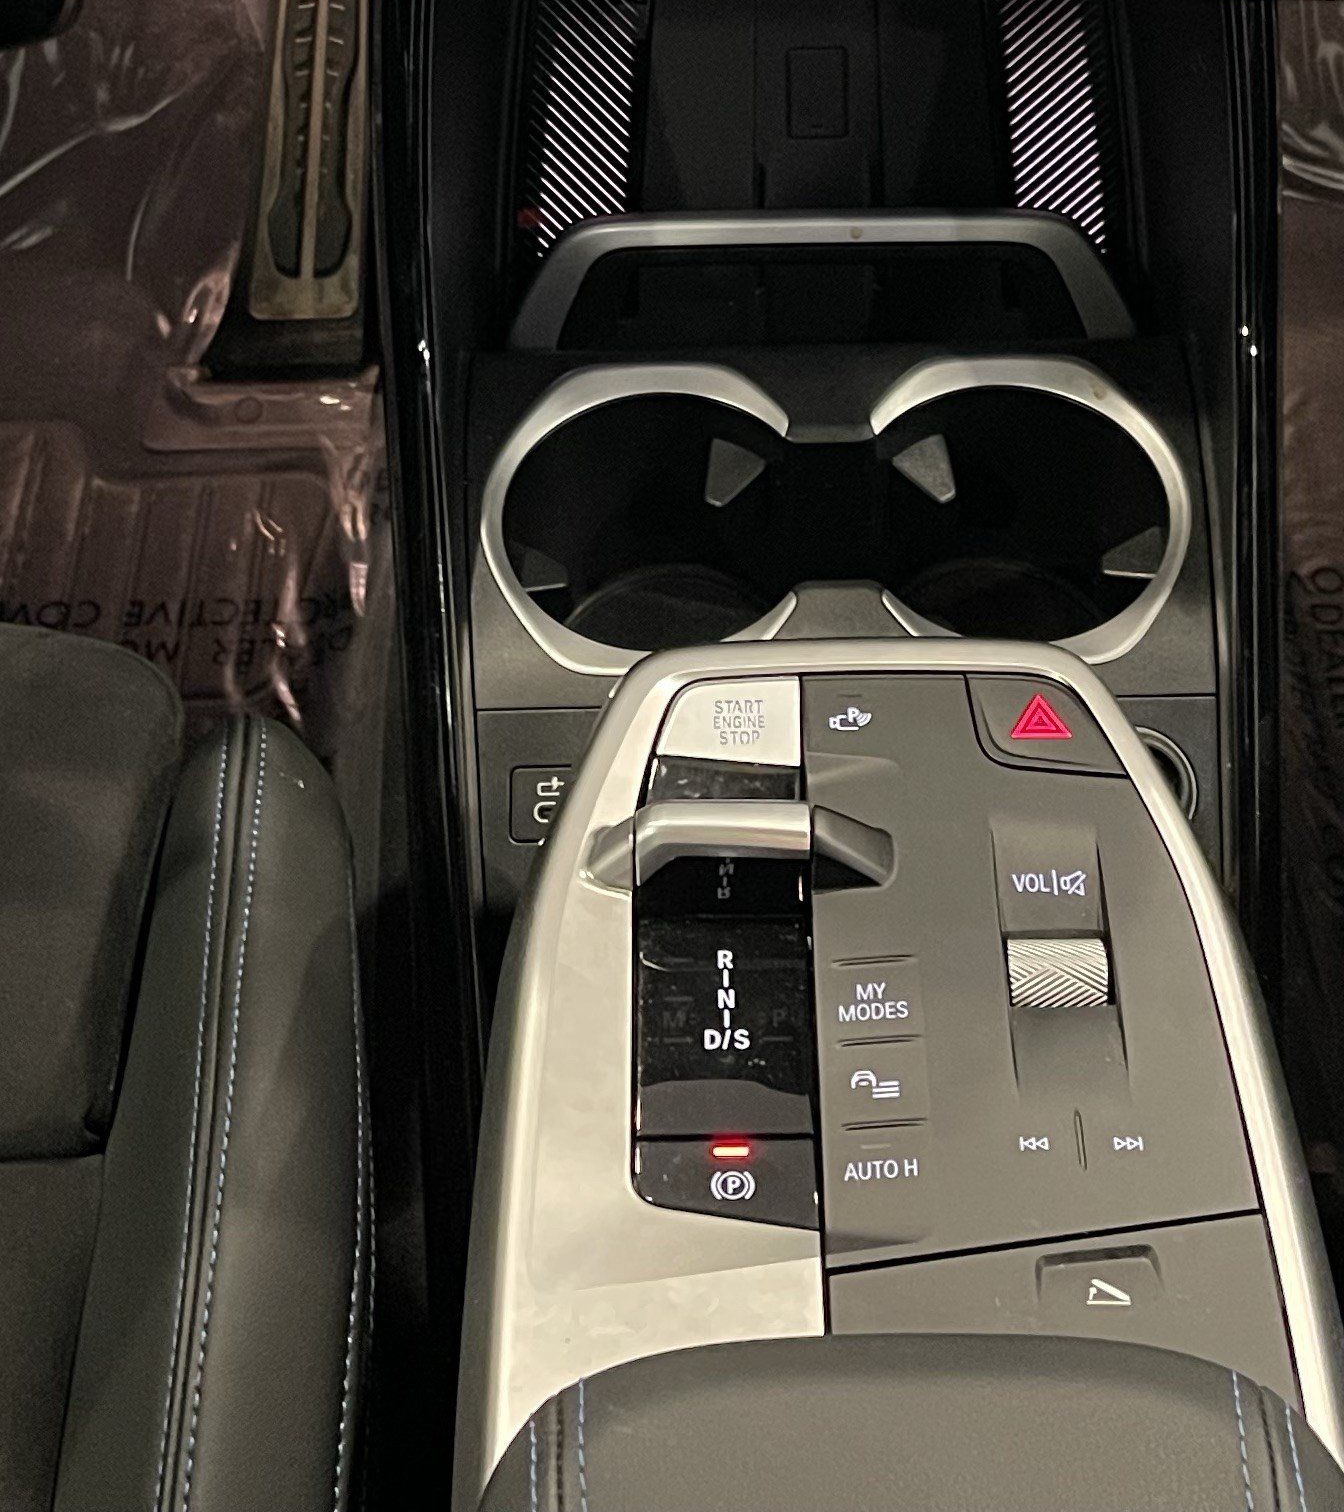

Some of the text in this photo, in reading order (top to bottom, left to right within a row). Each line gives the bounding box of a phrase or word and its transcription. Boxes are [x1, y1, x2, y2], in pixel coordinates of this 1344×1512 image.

[713, 698, 764, 715] START
[712, 714, 766, 730] ENGINE
[718, 729, 761, 746] STOP
[1011, 872, 1051, 894] VOL
[716, 948, 734, 970] R
[717, 988, 736, 1009] N
[855, 983, 887, 1001] MY
[837, 1000, 909, 1022] MODES
[703, 1028, 751, 1051] D/S
[843, 1158, 920, 1181] AUTO H
